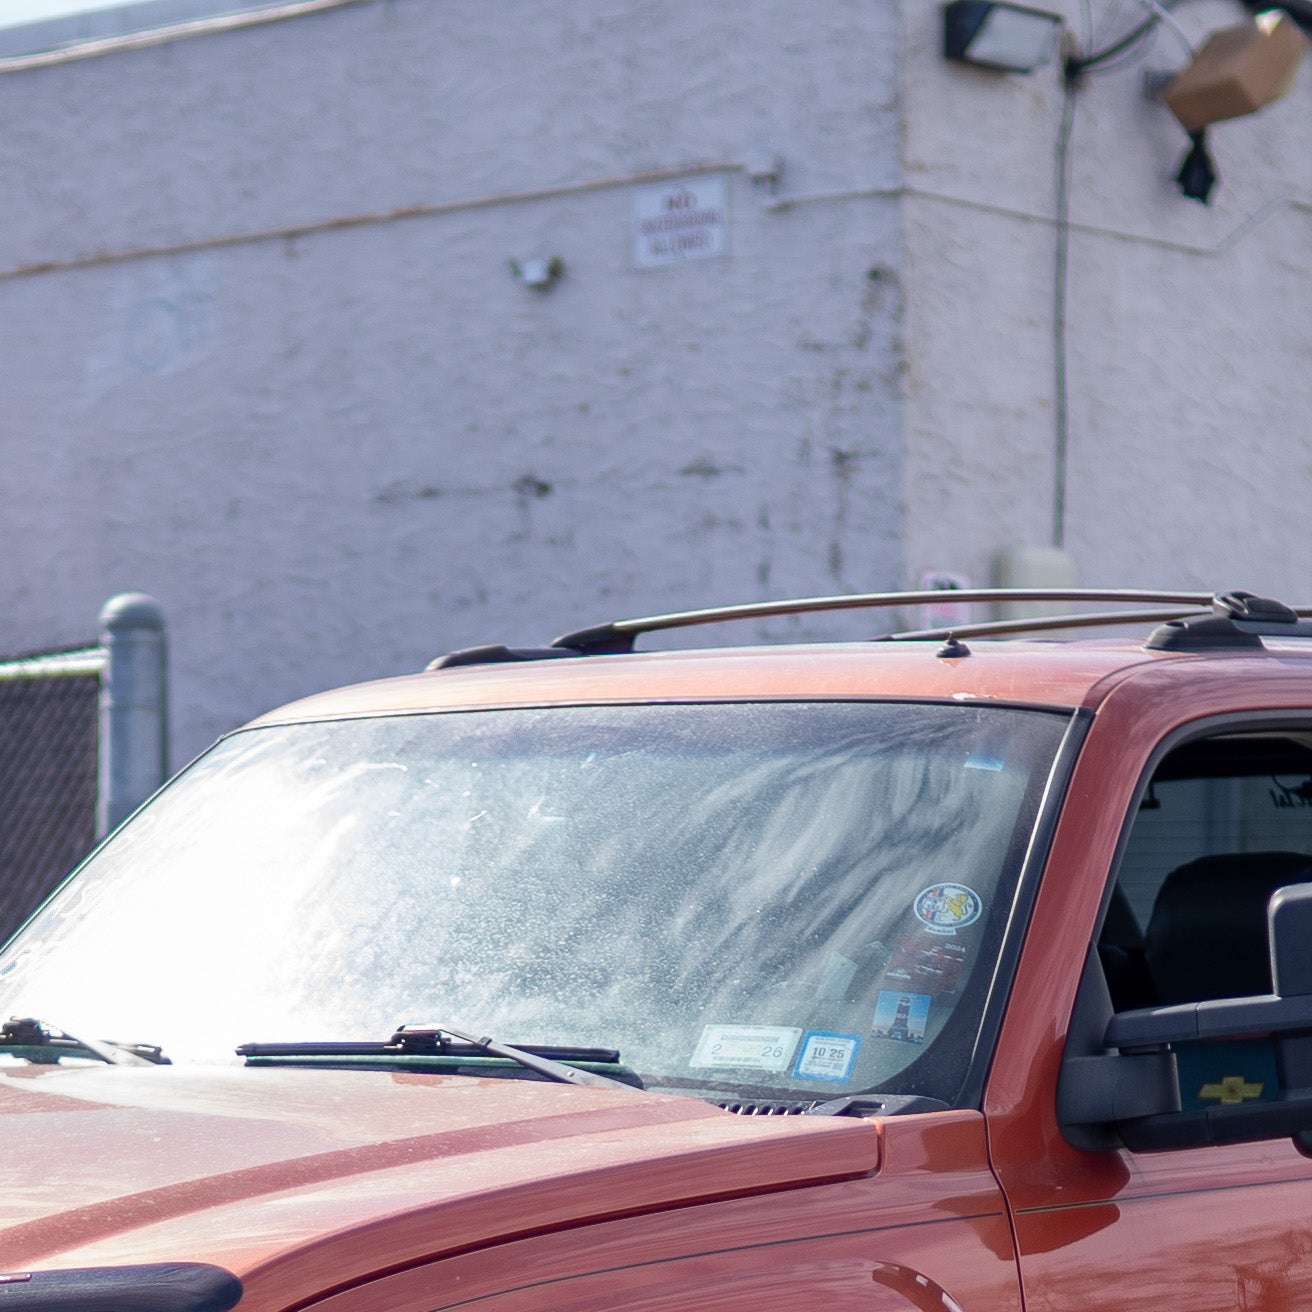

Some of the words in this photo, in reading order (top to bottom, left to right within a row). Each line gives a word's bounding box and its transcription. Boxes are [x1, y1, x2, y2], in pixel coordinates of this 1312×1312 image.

[761, 1046, 784, 1058] 26
[813, 1047, 826, 1057] 10
[829, 1048, 845, 1059] 25
